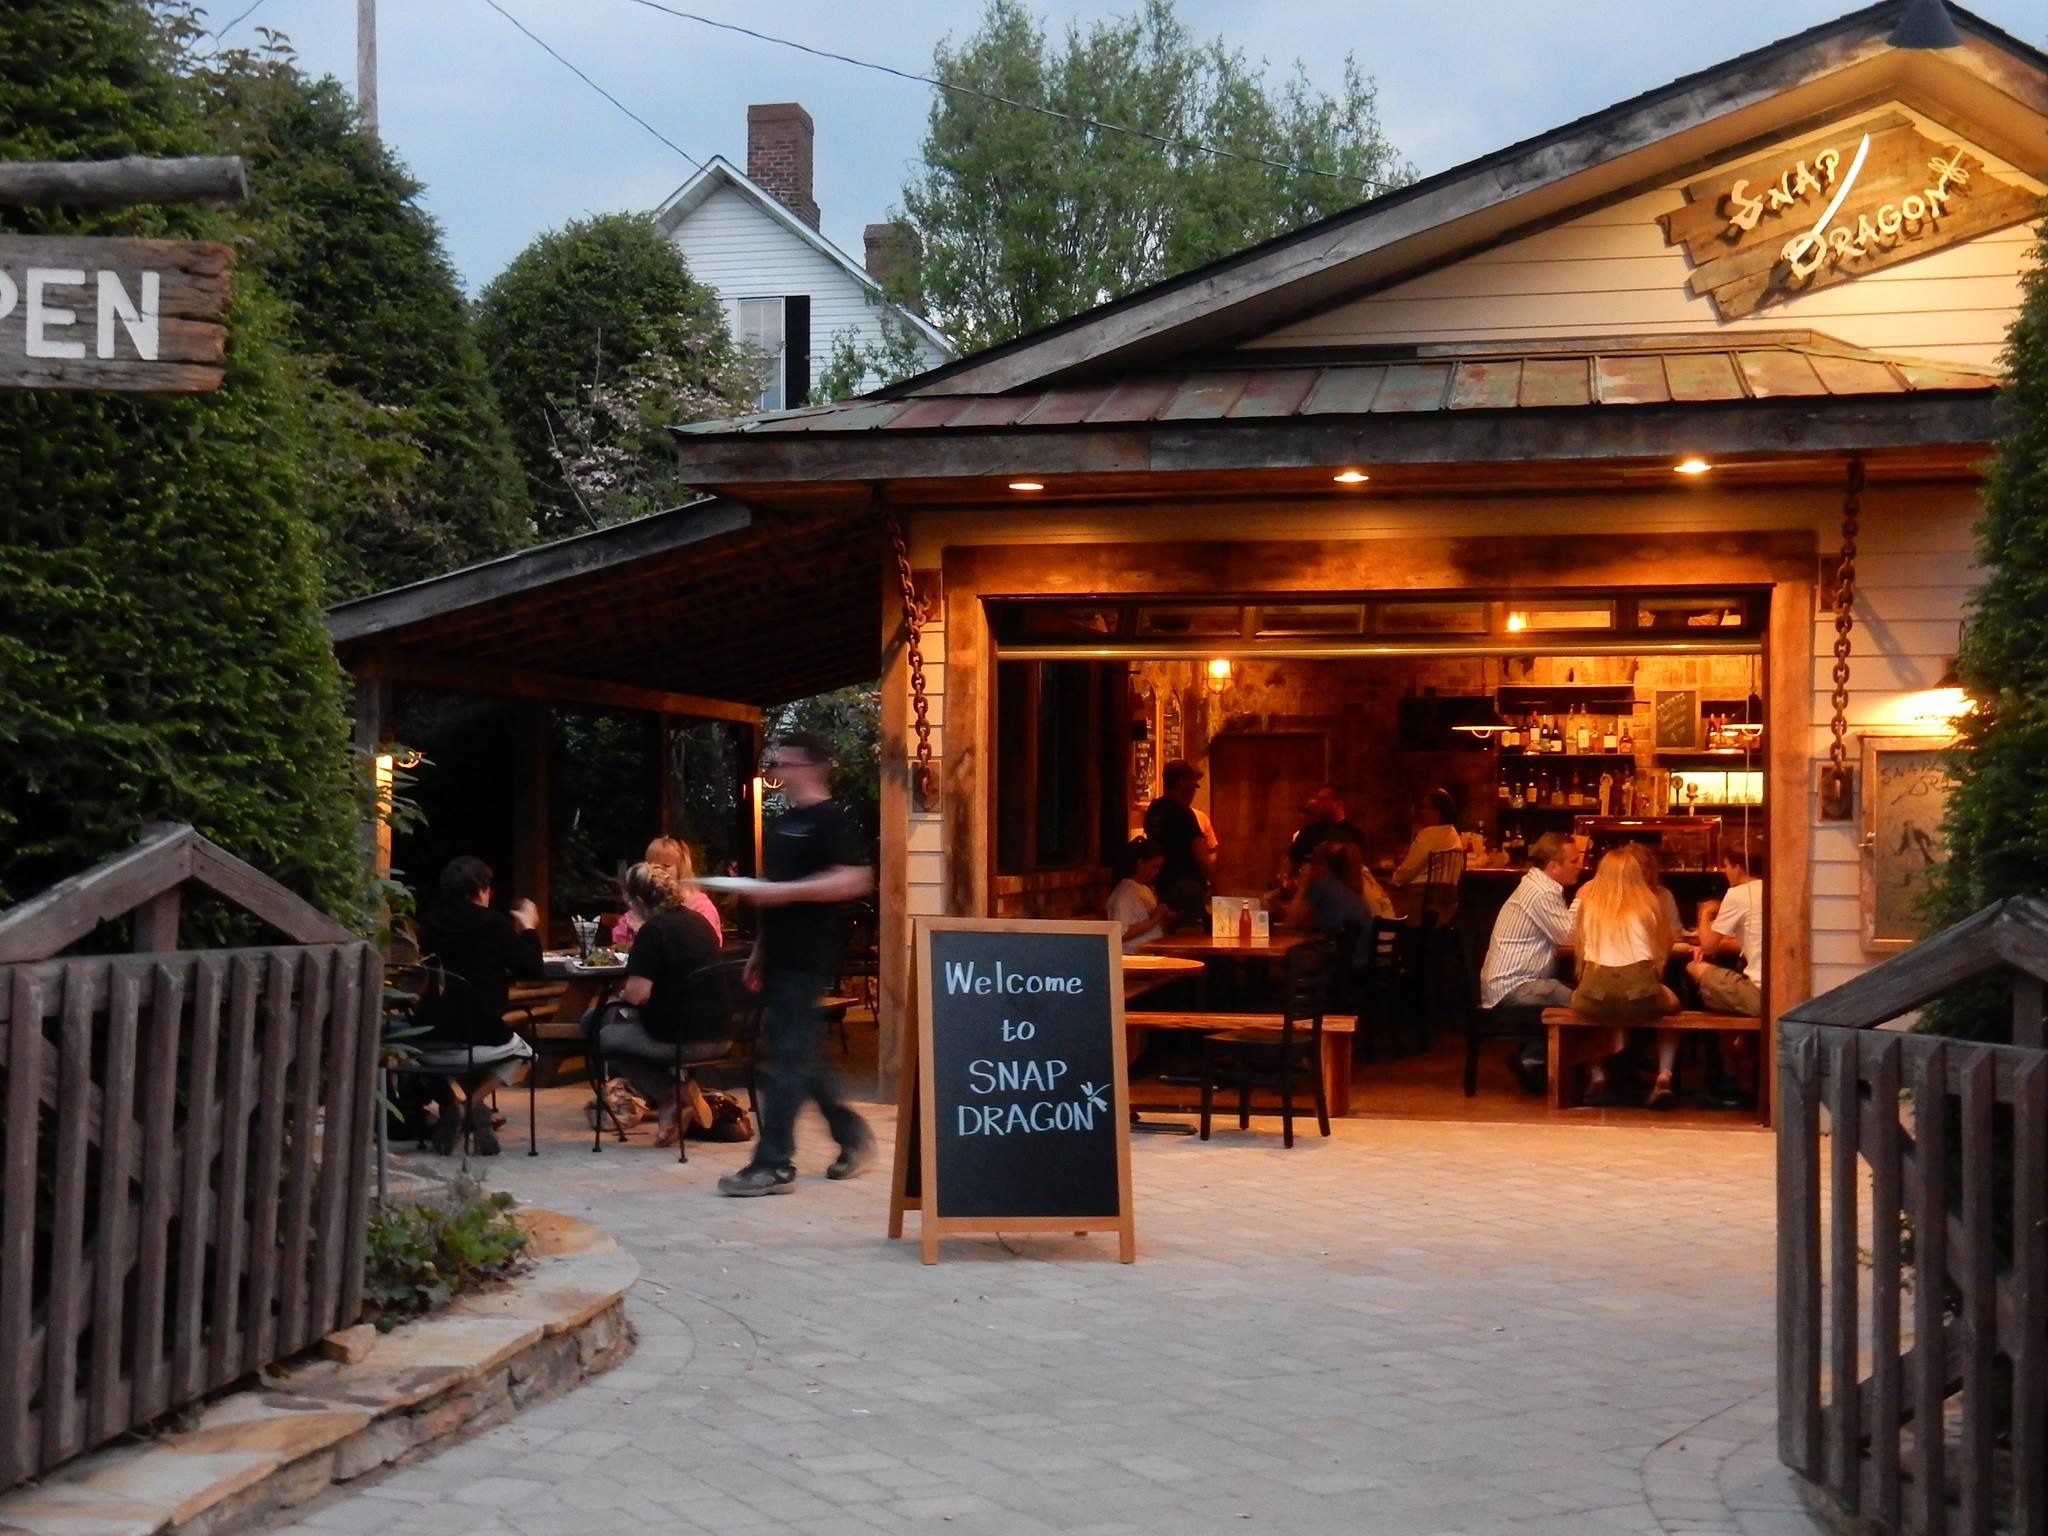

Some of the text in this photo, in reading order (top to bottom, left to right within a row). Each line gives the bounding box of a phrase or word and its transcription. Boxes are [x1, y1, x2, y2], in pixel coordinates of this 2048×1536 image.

[1730, 149, 1841, 230] SNAP
[1782, 175, 1951, 280] DRAGON
[945, 961, 1083, 995] Welcome
[1000, 1019, 1036, 1042] to
[968, 1059, 1068, 1095] SNAP
[958, 1101, 1094, 1136] DRAGON
